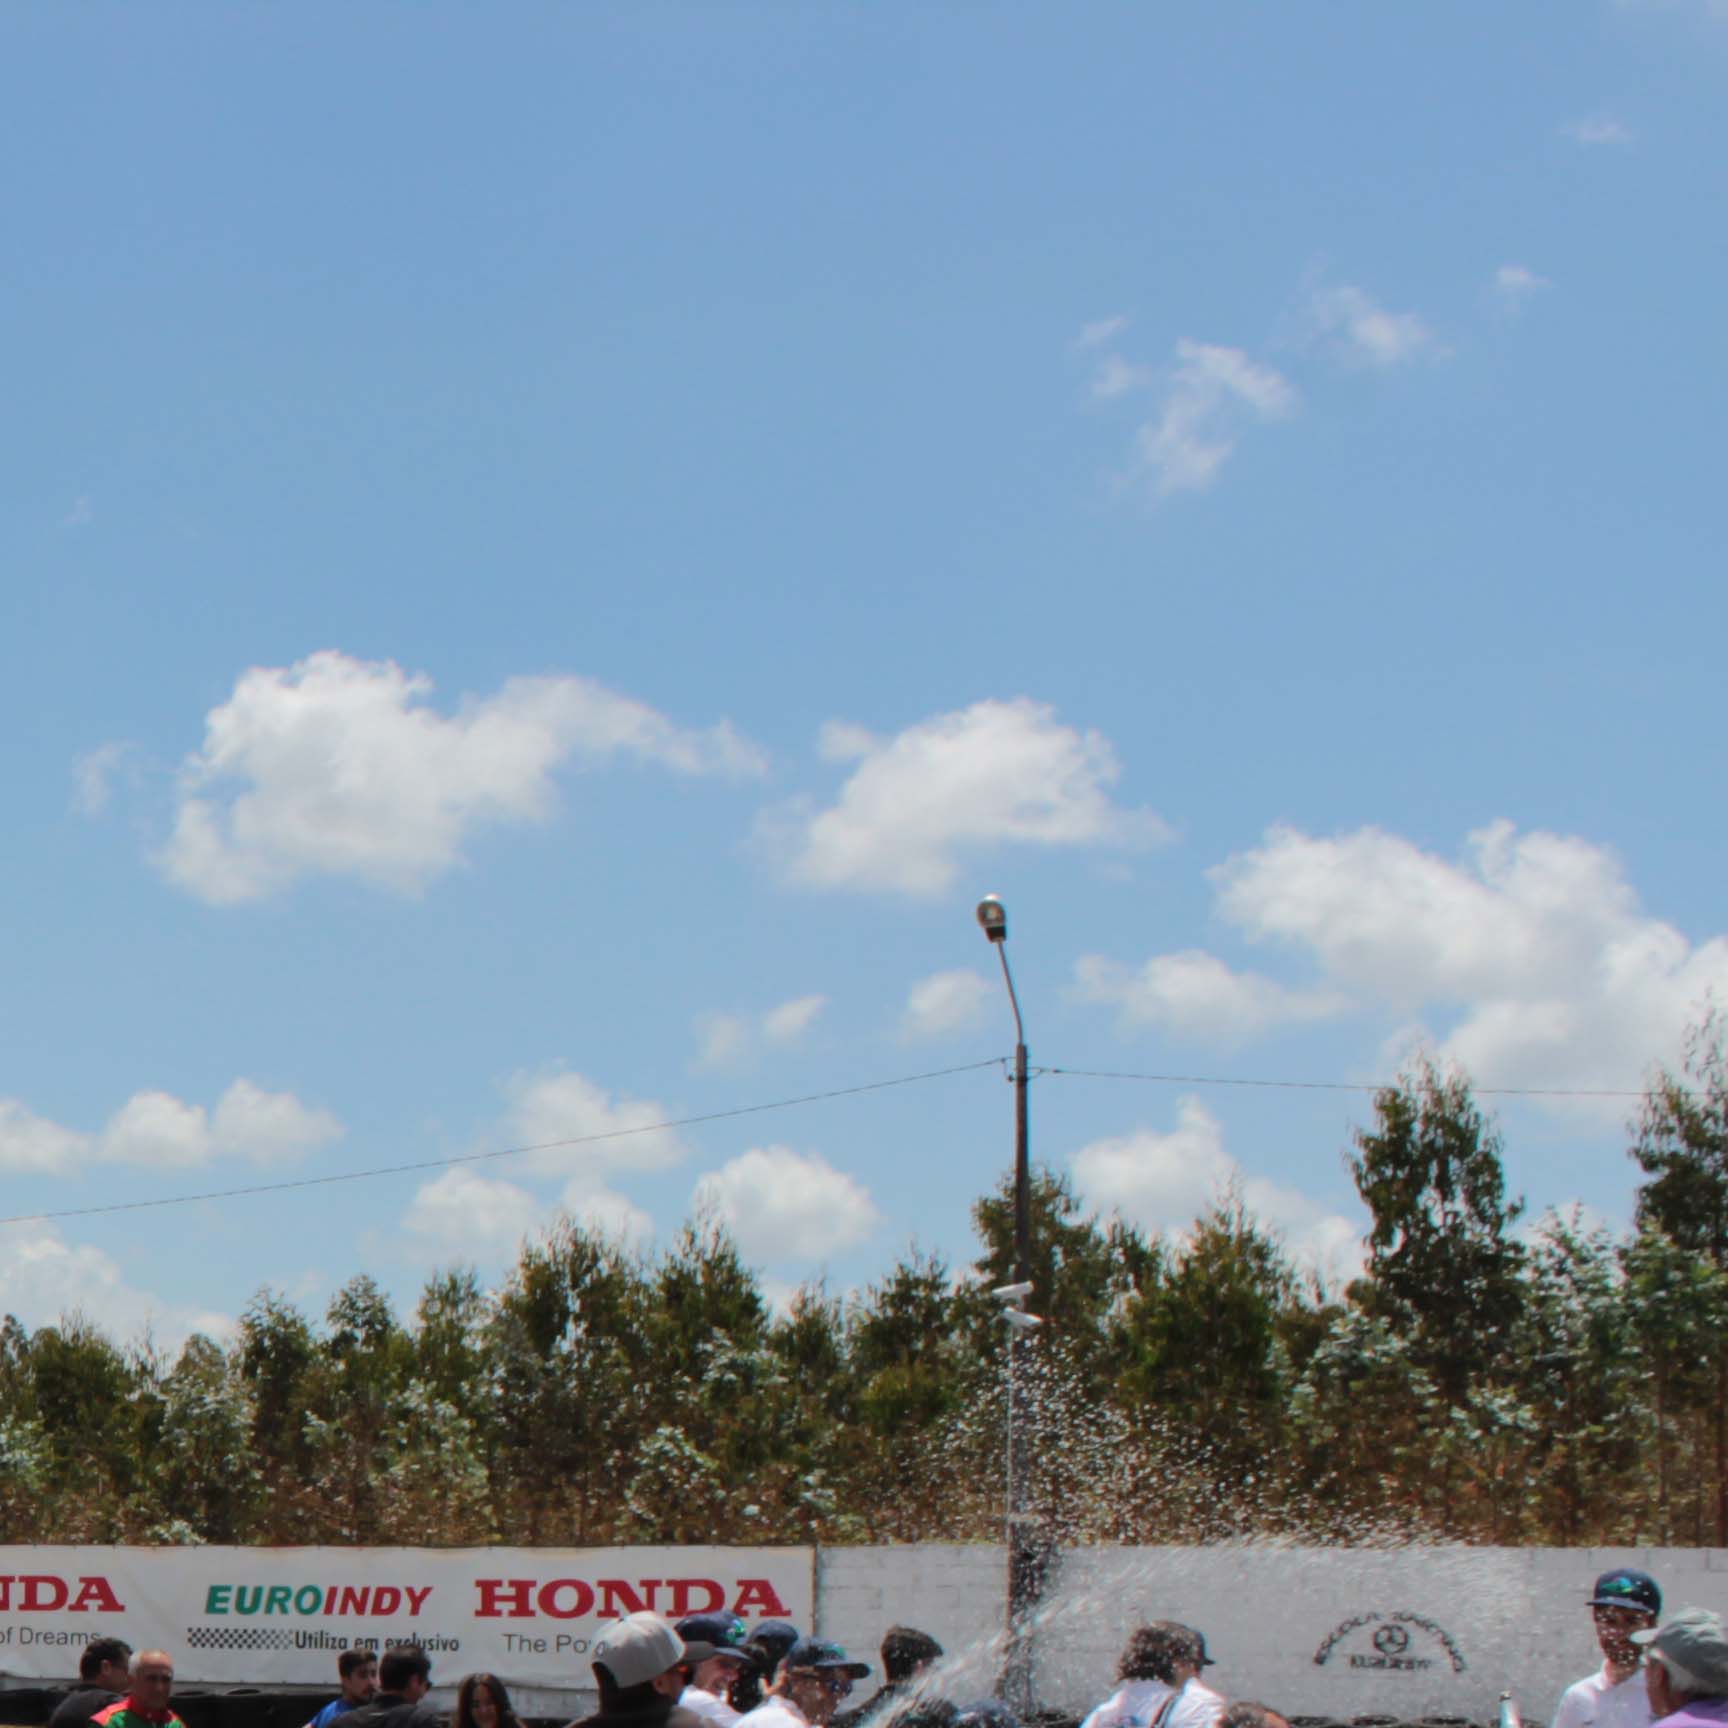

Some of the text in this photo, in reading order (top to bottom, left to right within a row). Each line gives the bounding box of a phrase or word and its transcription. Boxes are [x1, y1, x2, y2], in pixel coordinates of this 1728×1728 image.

[204, 1584, 433, 1616] EUROINDY
[473, 1578, 792, 1619] HONDA
[18, 1627, 101, 1646] Dreams
[294, 1630, 348, 1650] Utiliza
[353, 1636, 379, 1651] em
[503, 1634, 548, 1654] The
